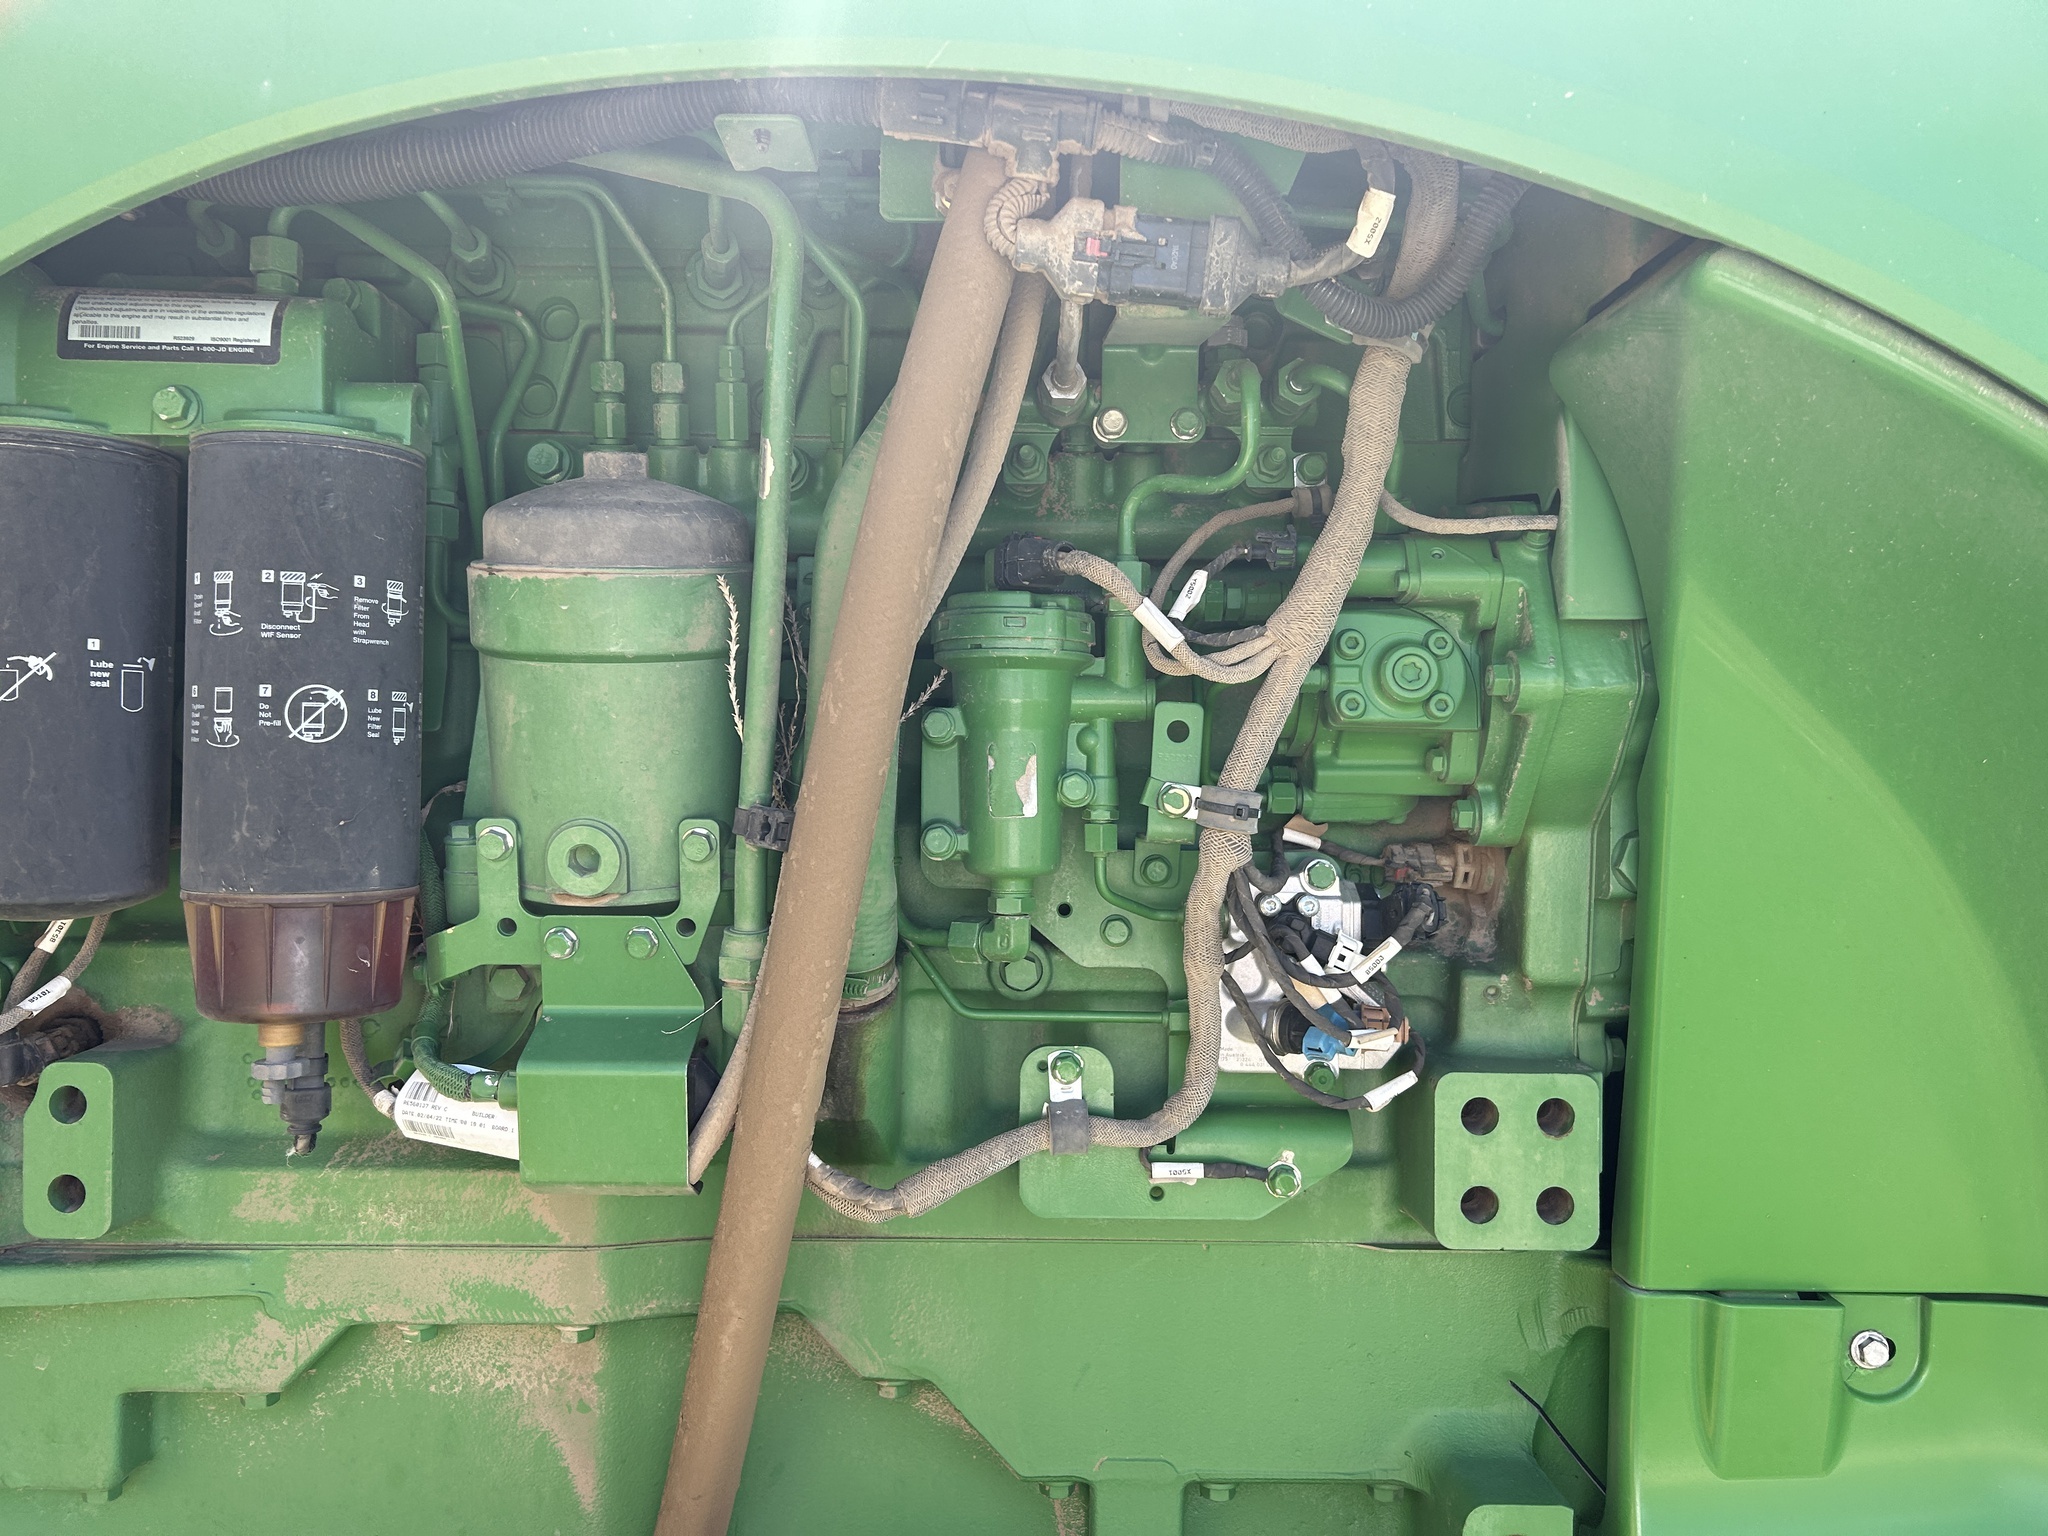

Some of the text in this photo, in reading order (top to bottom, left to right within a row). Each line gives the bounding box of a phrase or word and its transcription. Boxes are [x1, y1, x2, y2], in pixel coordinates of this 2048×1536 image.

[1364, 217, 1382, 245] X5002
[353, 596, 379, 605] Remove
[353, 604, 370, 612] Filter
[353, 612, 370, 620] From
[260, 623, 301, 631] Disconnect
[352, 637, 390, 646] Strapwrench
[90, 660, 114, 669] Lube
[89, 680, 110, 688] seal
[402, 1109, 414, 1117] DATE
[445, 1116, 458, 1124] TIME
[472, 1111, 496, 1119] BUILDER
